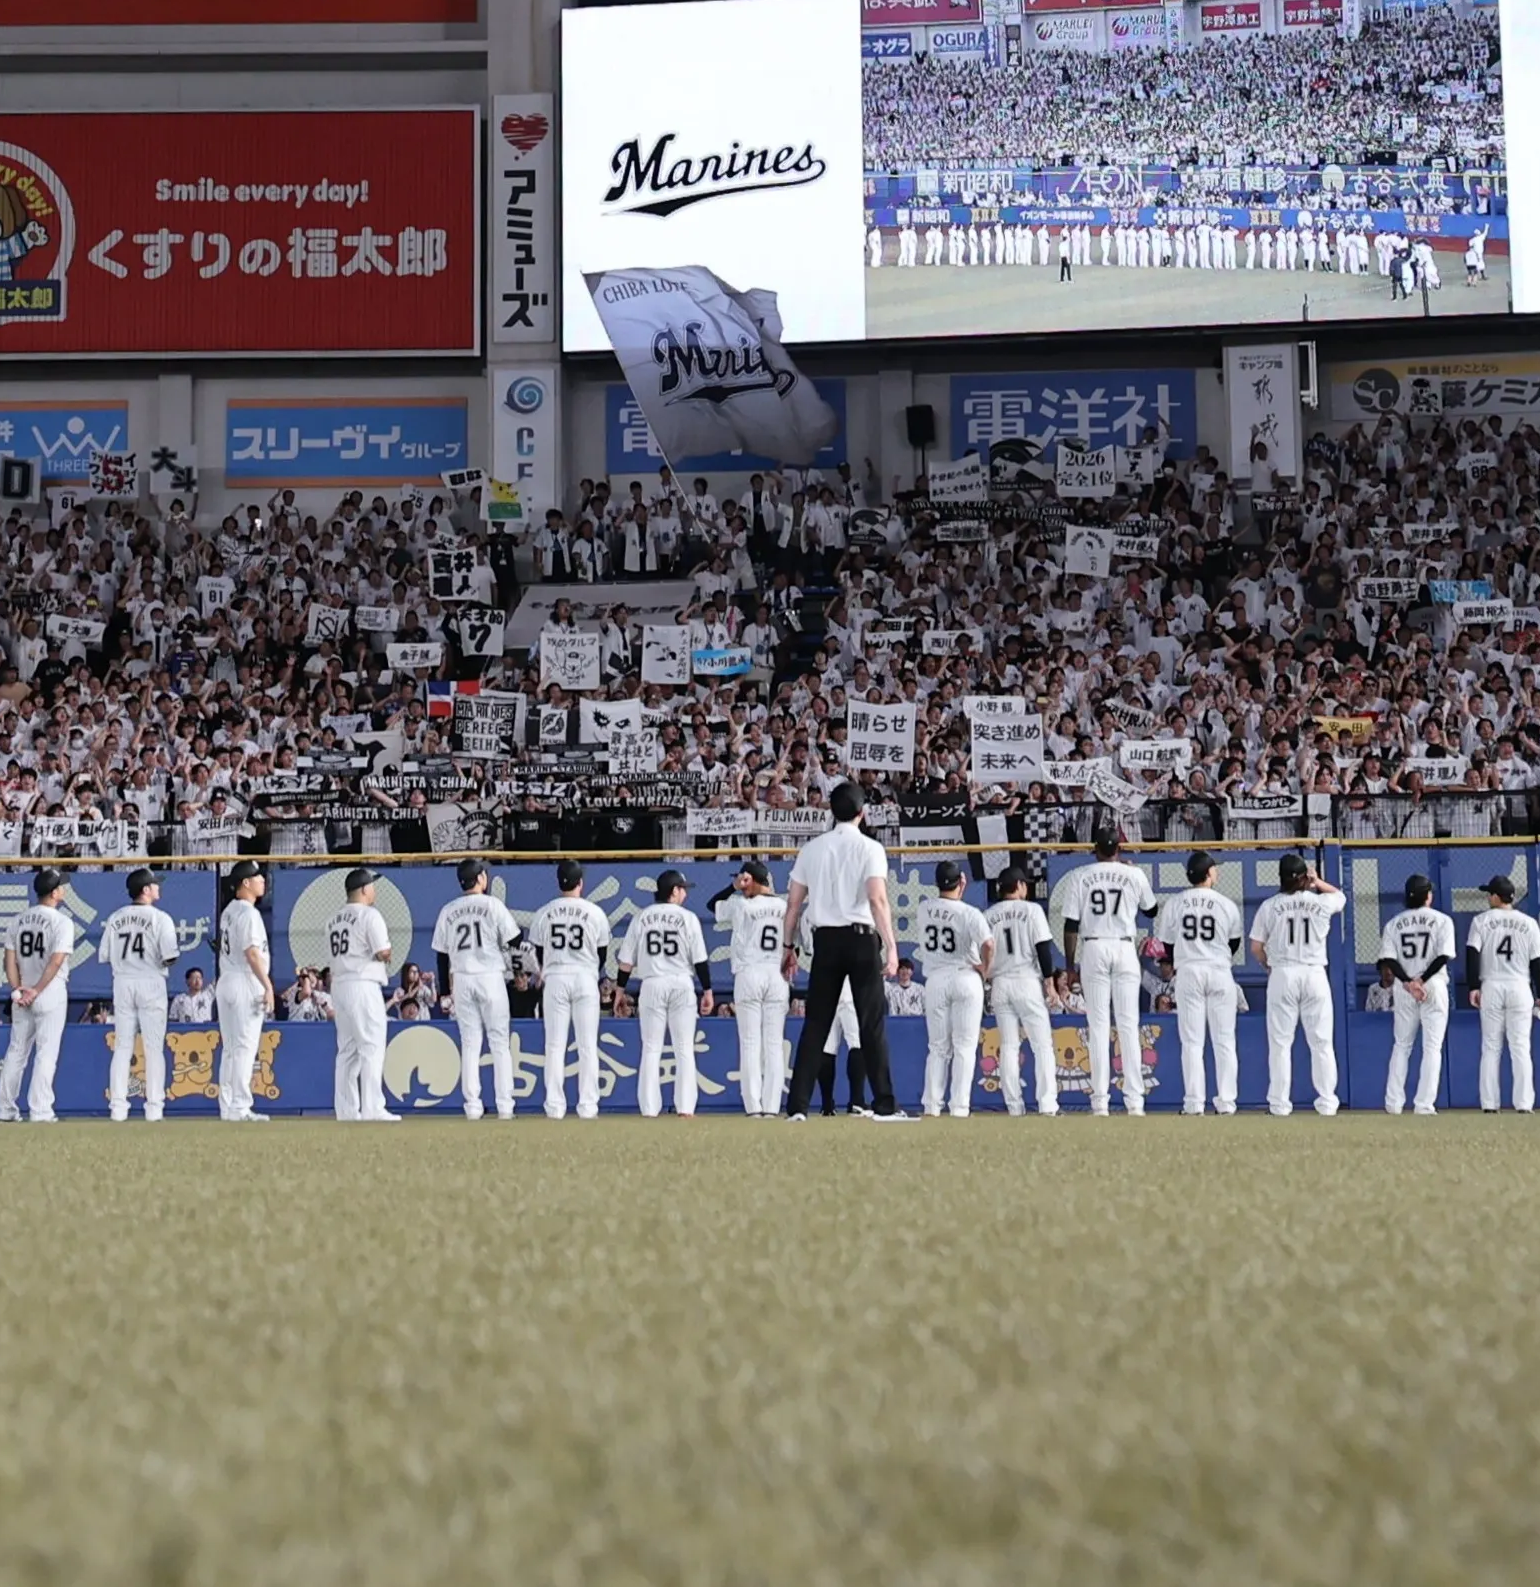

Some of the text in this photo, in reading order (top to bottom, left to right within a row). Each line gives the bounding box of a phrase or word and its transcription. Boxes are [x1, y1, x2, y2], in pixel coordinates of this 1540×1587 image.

[600, 134, 827, 214] Marines
[16, 175, 54, 218] day!
[155, 177, 369, 209] Smile every day!
[86, 226, 448, 280] くすりの福太郎
[502, 169, 548, 328] アミューズ
[602, 280, 650, 304] CHIBA
[964, 384, 1183, 448] 電洋社
[1065, 451, 1106, 467] 2026
[851, 713, 908, 733] 晴らせ
[973, 723, 1041, 742] 突き進め
[850, 743, 905, 763] 屈辱を
[980, 752, 1036, 771] 未来へ
[764, 809, 828, 823] FUJIWARA
[903, 803, 967, 818] マリーンズ
[547, 906, 589, 921] KIMURA
[1090, 889, 1122, 916] 97
[1183, 897, 1215, 911] SOTO
[640, 911, 686, 928] TERACHI
[1182, 915, 1215, 941] 99
[1287, 918, 1310, 945] 11
[19, 931, 45, 958] 84
[117, 932, 145, 959] 74
[329, 928, 349, 957] 66
[457, 921, 483, 950] 21
[550, 923, 584, 951] 53
[646, 929, 679, 956] 65
[760, 925, 777, 952] 6
[924, 925, 956, 954] 33
[1002, 928, 1012, 955] 1
[1400, 932, 1431, 959] 57
[1496, 935, 1514, 961] 4
